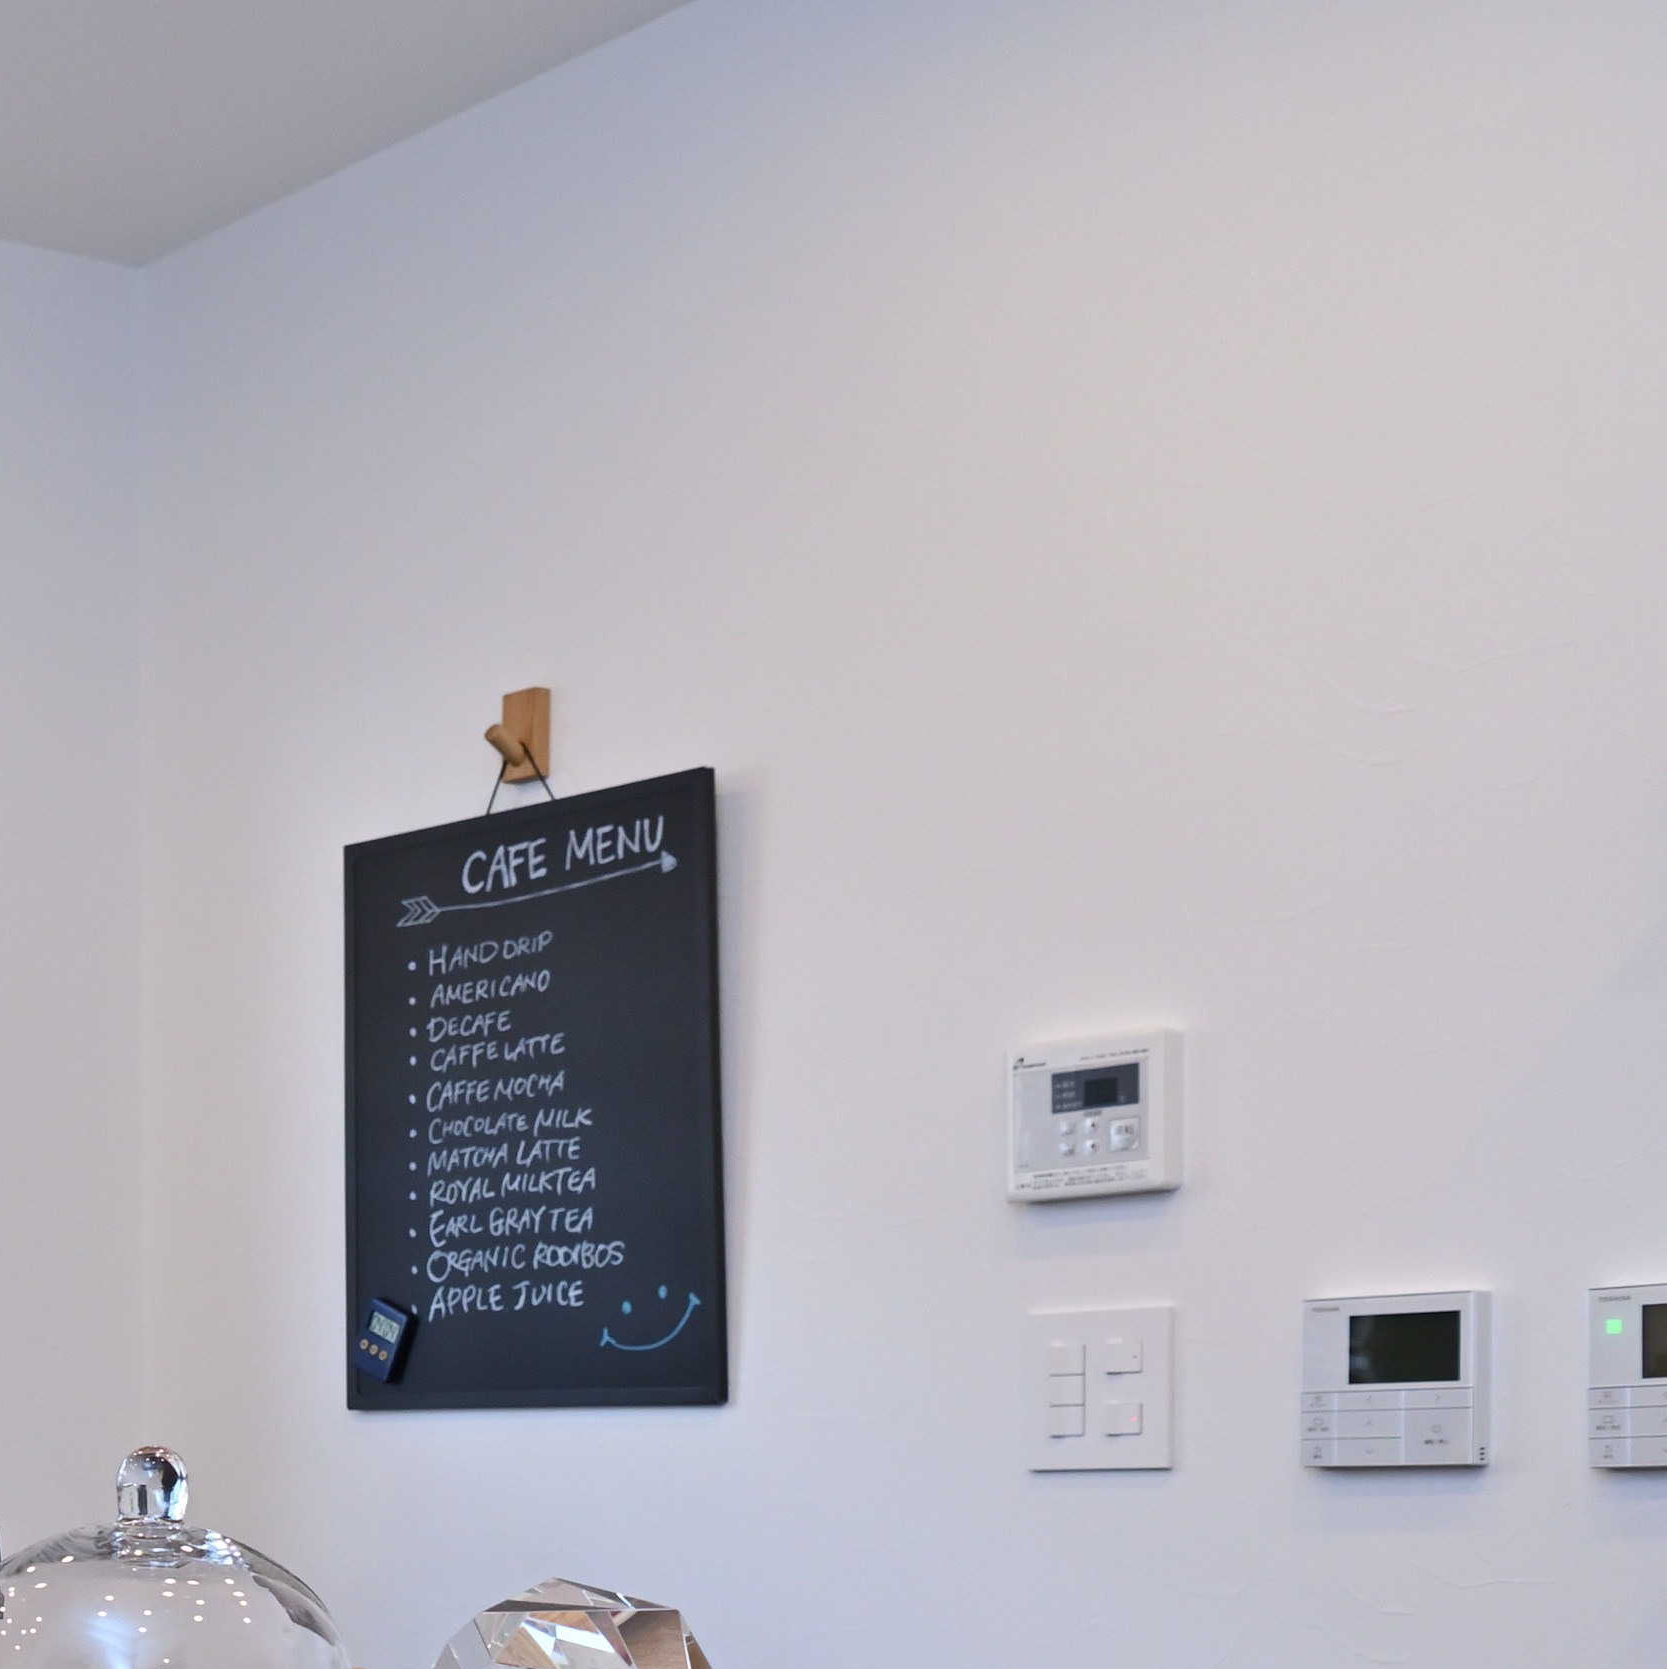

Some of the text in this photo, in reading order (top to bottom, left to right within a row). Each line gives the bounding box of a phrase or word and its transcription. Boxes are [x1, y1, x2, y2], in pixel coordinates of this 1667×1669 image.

[462, 815, 665, 894] CAFE MENU
[430, 968, 552, 1008] AMERICANO
[426, 1010, 512, 1043] DECAFE
[430, 1032, 565, 1073] CAFFE LATTE
[426, 1070, 566, 1112] CAFFE MOCHA
[428, 1107, 594, 1144] CHOCOLATE MILK
[427, 1136, 581, 1177] MATCHA LATTE
[429, 1176, 495, 1207] ROYAL
[426, 1240, 626, 1283] ORGANIC ROOIBOS
[428, 1280, 584, 1323] APPLE JUICE
